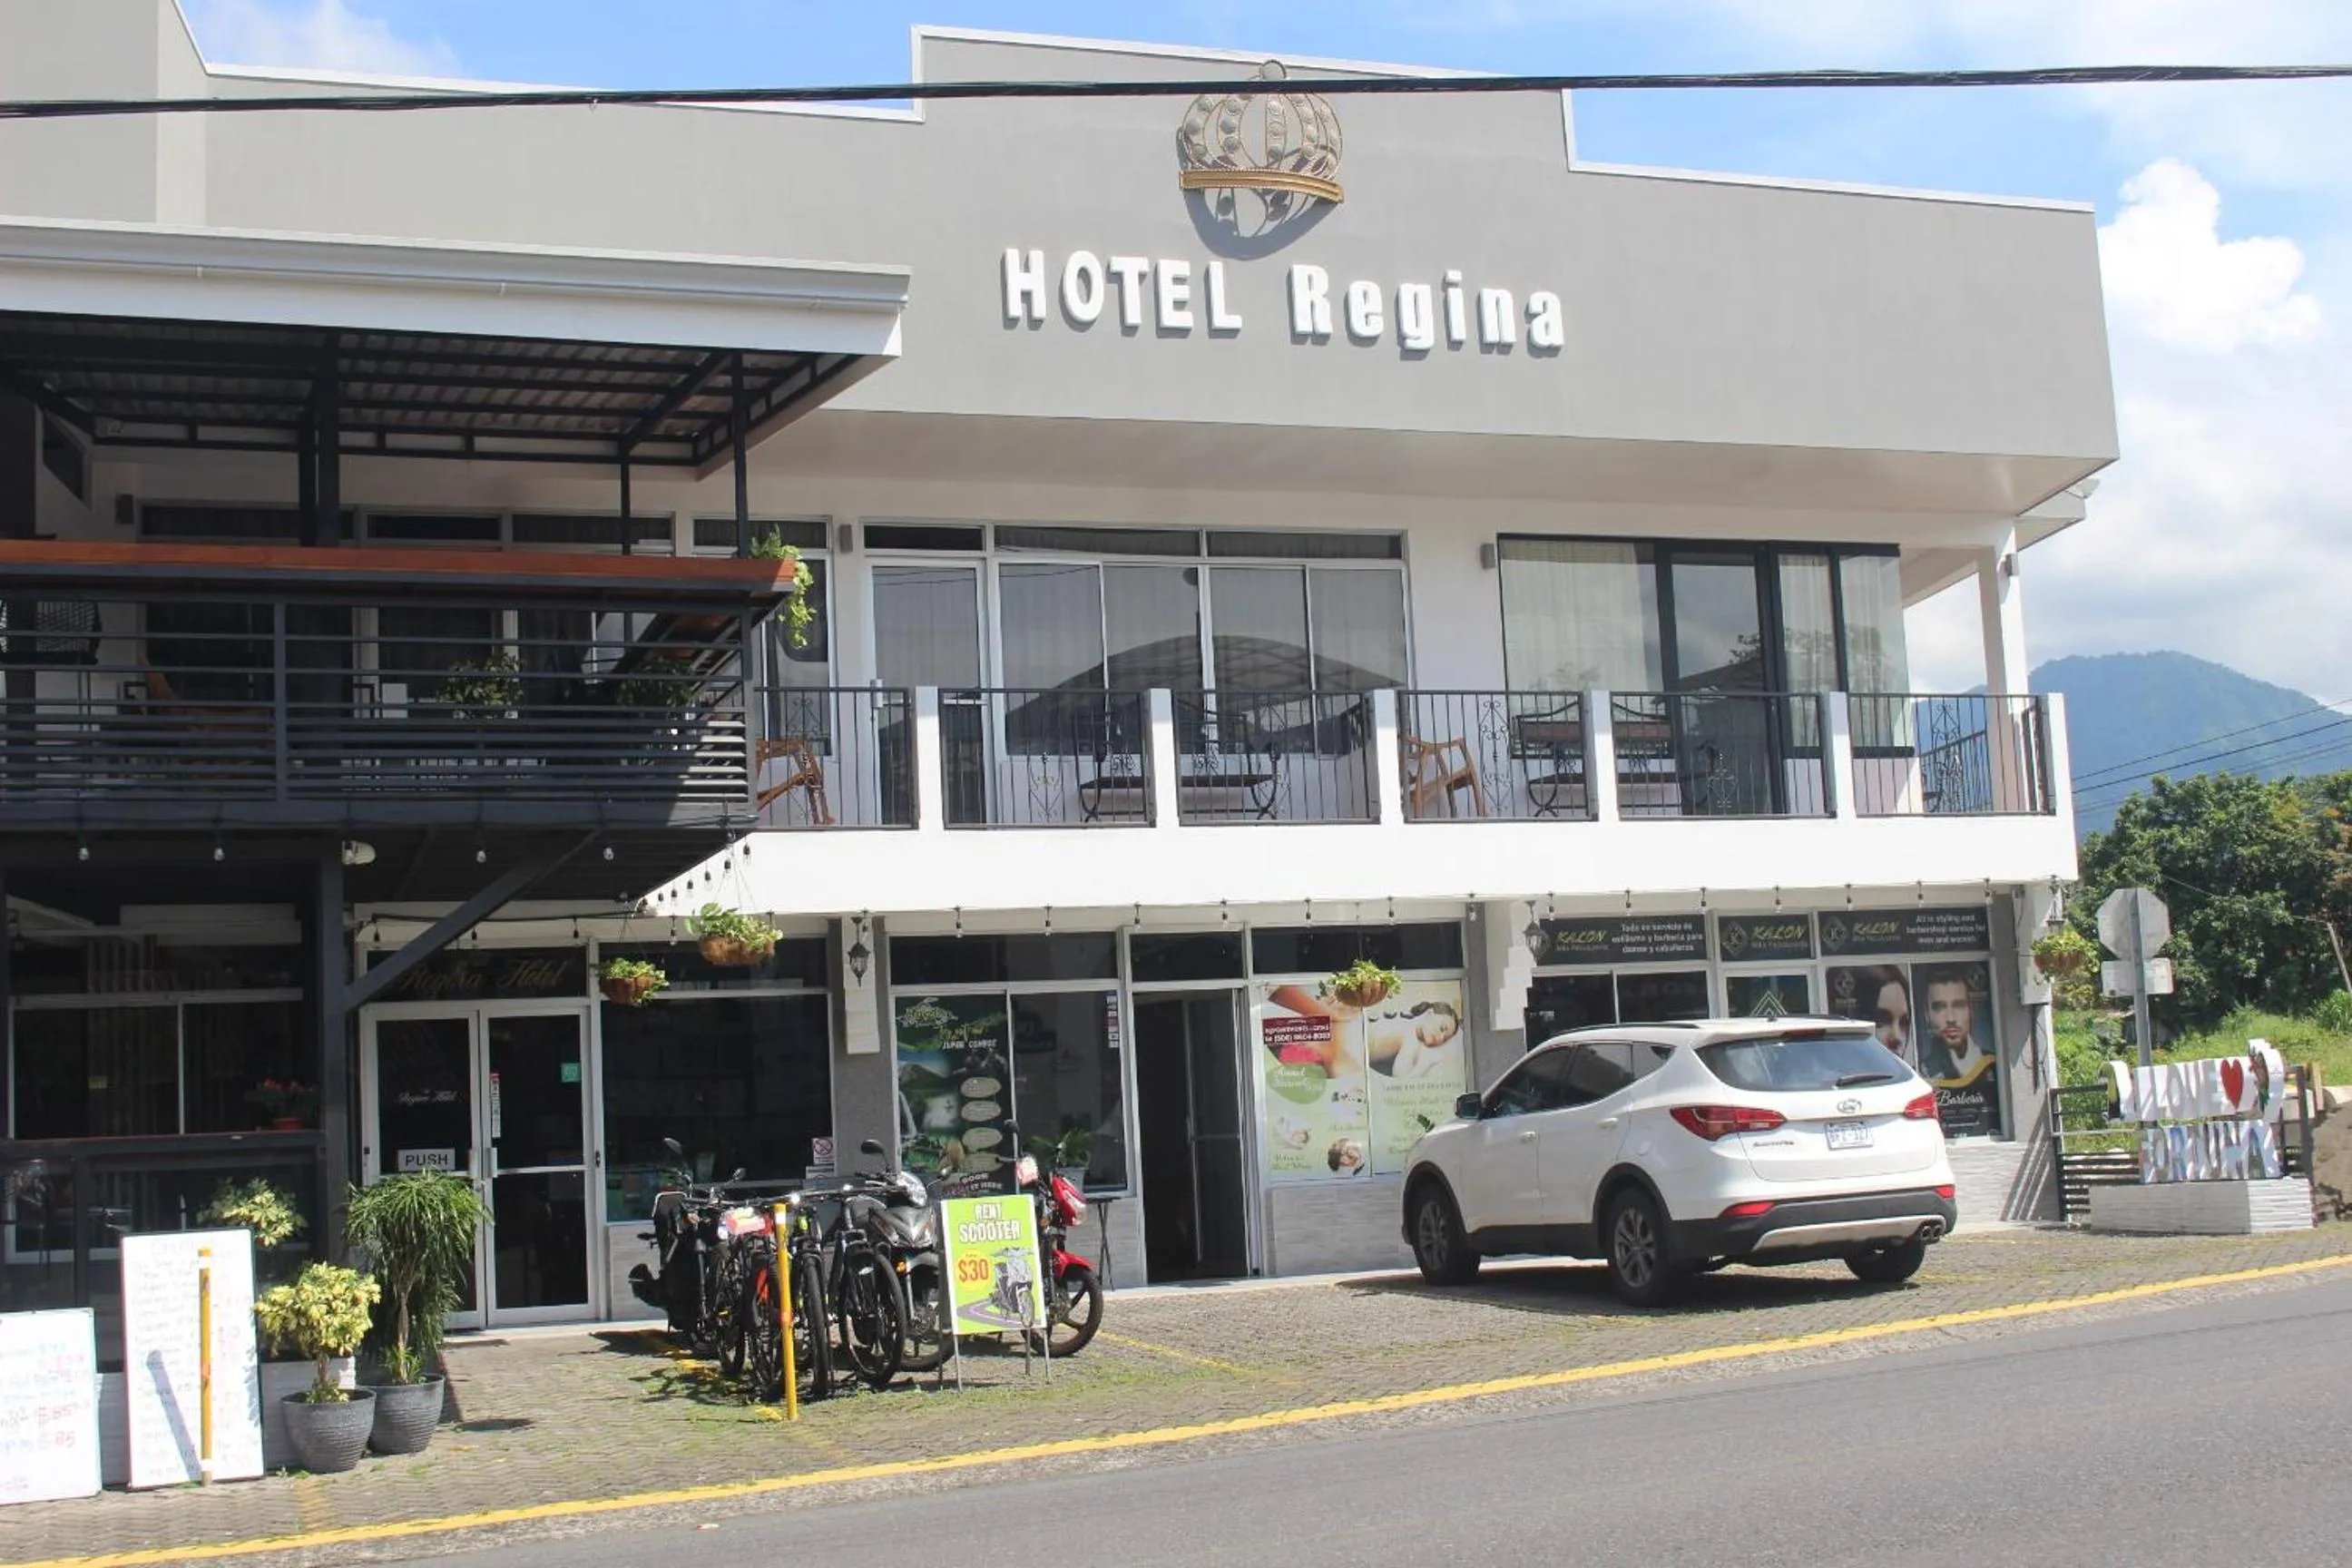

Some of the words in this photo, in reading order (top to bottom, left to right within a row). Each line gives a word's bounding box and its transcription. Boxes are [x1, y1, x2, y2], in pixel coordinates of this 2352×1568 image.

[1003, 247, 1243, 334] HOTEL
[1289, 263, 1564, 352] Regina
[1752, 925, 1806, 939] KALON
[1852, 921, 1901, 935] KALON
[1555, 930, 1607, 944] KALON
[405, 1153, 449, 1167] PUSH
[975, 1202, 1003, 1220] RENT
[958, 1220, 1021, 1243] SCOOTER
[957, 1259, 989, 1283] $30
